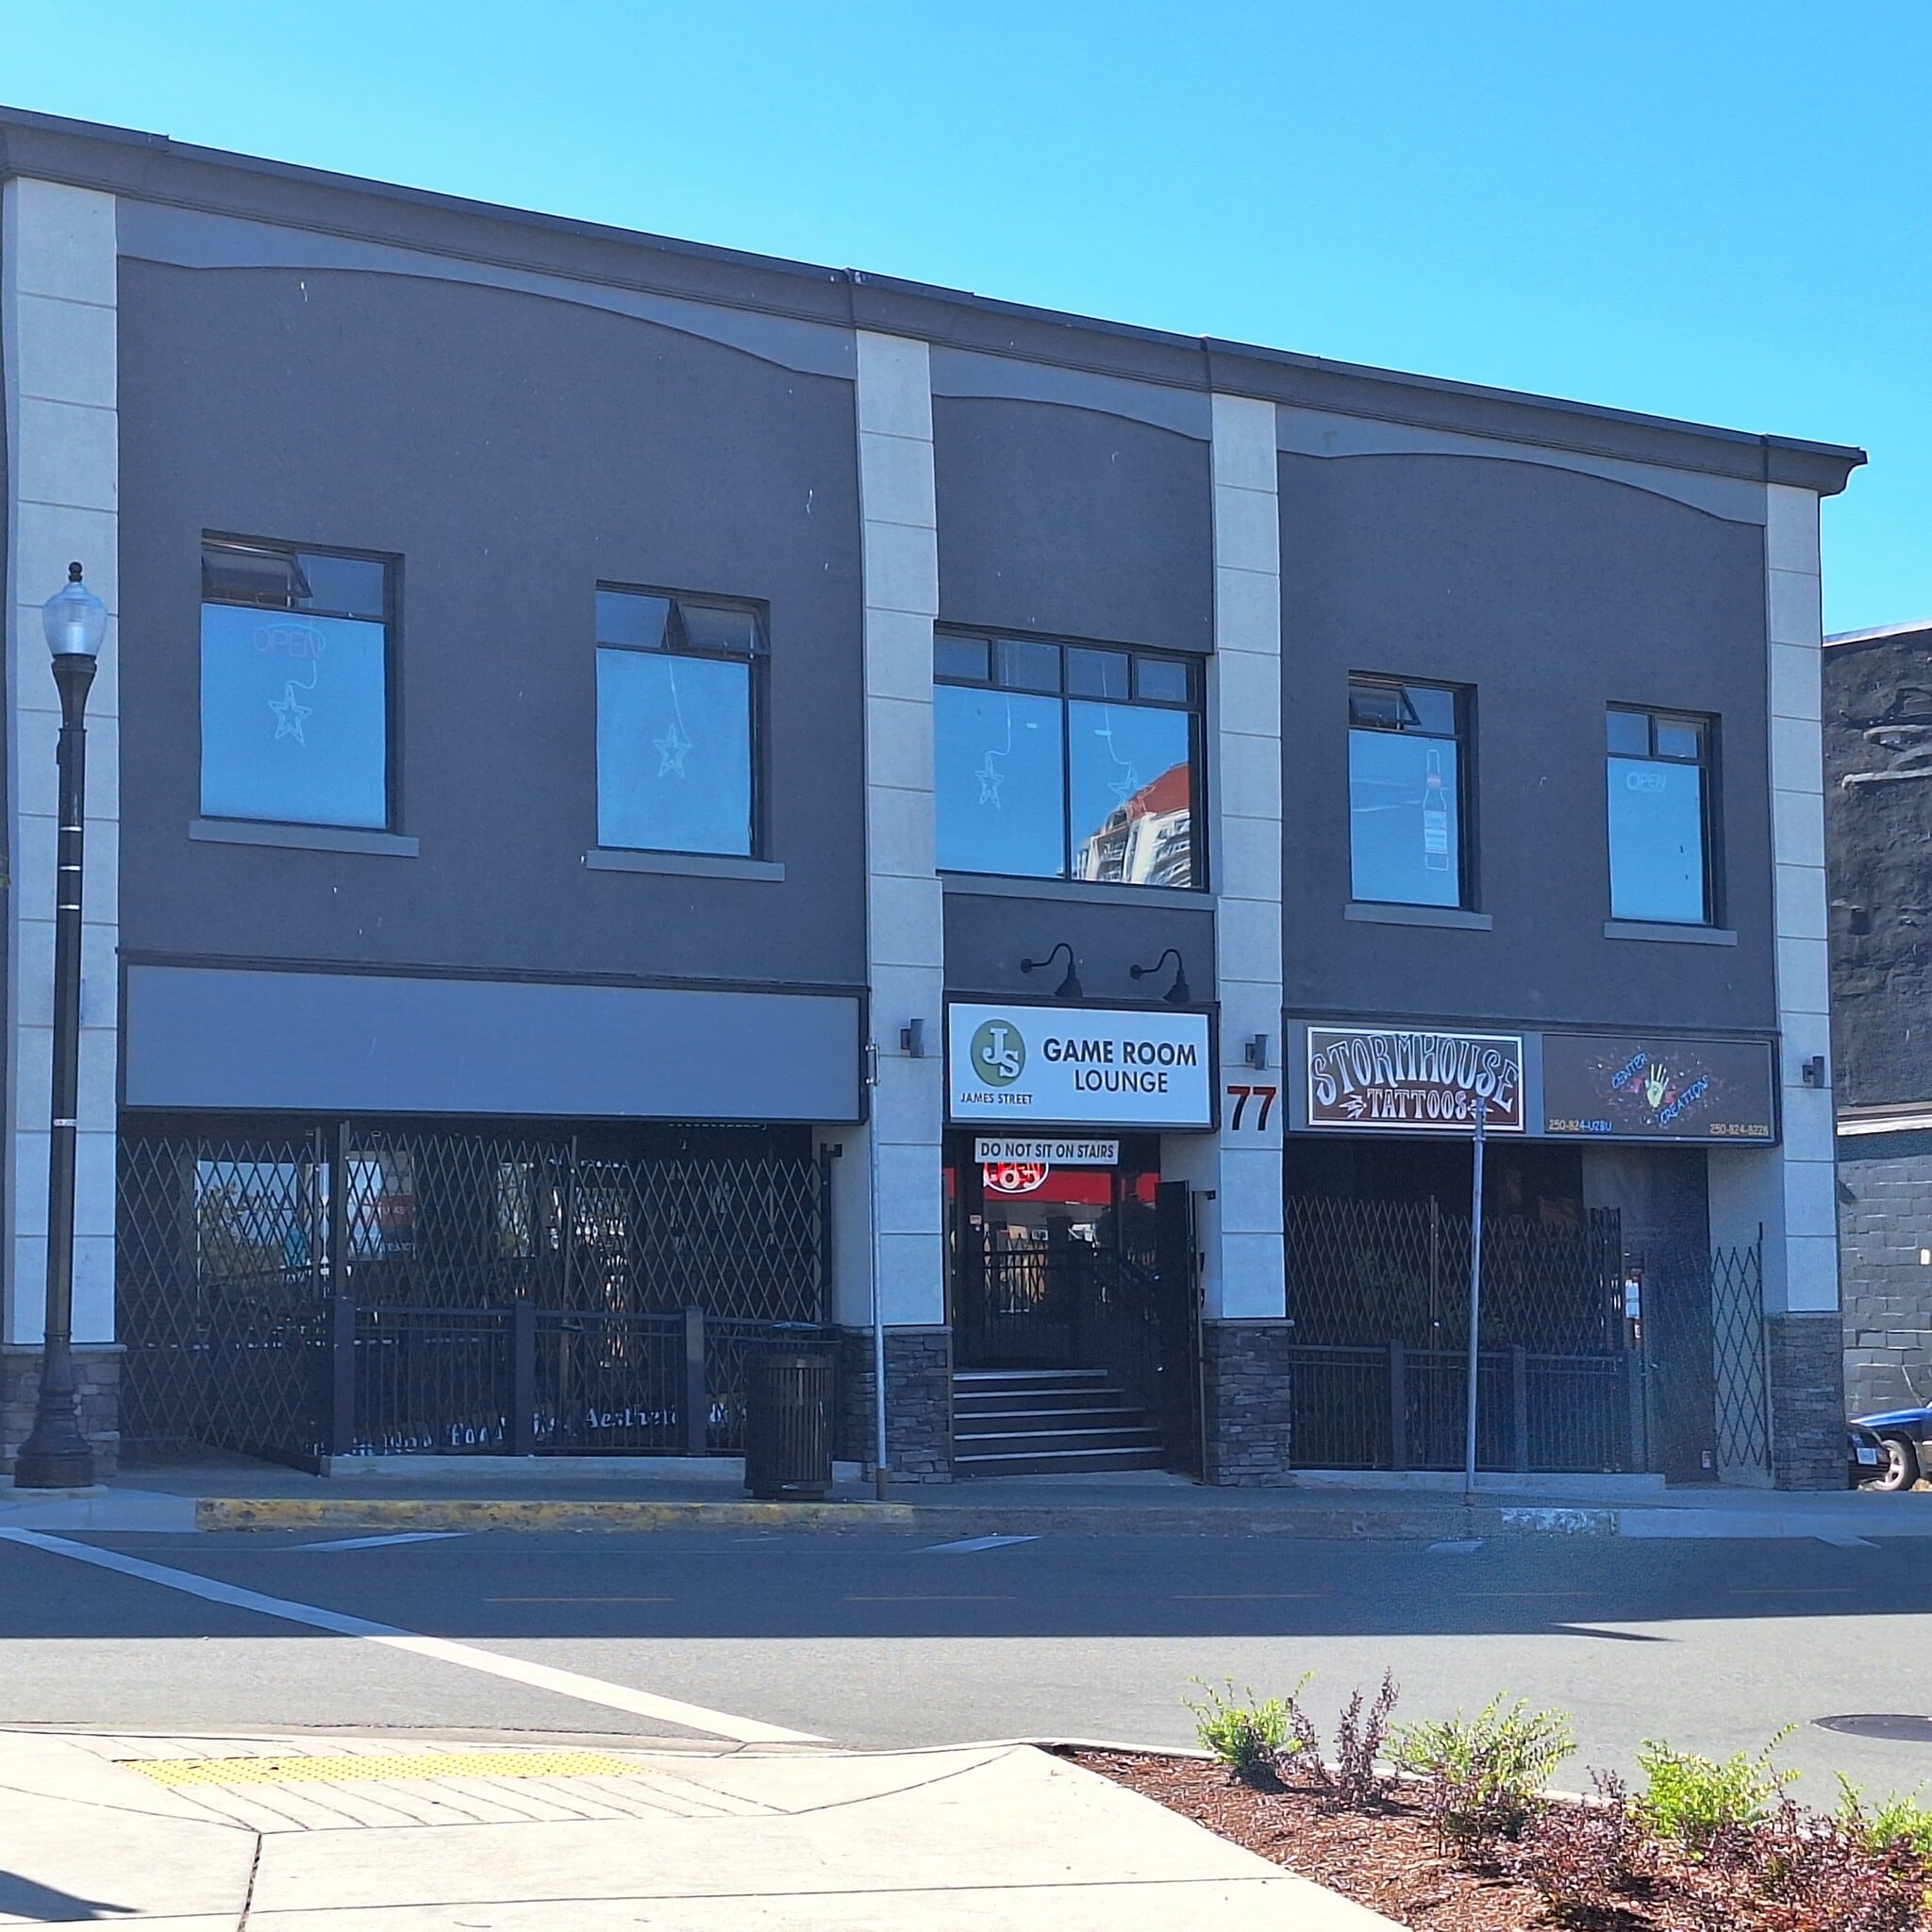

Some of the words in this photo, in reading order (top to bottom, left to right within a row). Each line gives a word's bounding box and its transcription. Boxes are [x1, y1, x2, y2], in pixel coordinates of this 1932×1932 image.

[1042, 1039, 1114, 1064] GAME
[1123, 1041, 1197, 1067] ROOM
[1074, 1069, 1169, 1093] LOUNGE
[1311, 1034, 1520, 1114] STORMHOUSE
[960, 1092, 994, 1104] JAMES
[998, 1093, 1033, 1105] STREET
[1227, 1086, 1277, 1131] 77
[1367, 1088, 1468, 1120] TATTOOS
[980, 1142, 1002, 1157] DO
[1006, 1143, 1032, 1158] NOT
[1035, 1143, 1052, 1158] SIT
[1056, 1144, 1074, 1158] ON
[1077, 1144, 1114, 1158] STAIRS
